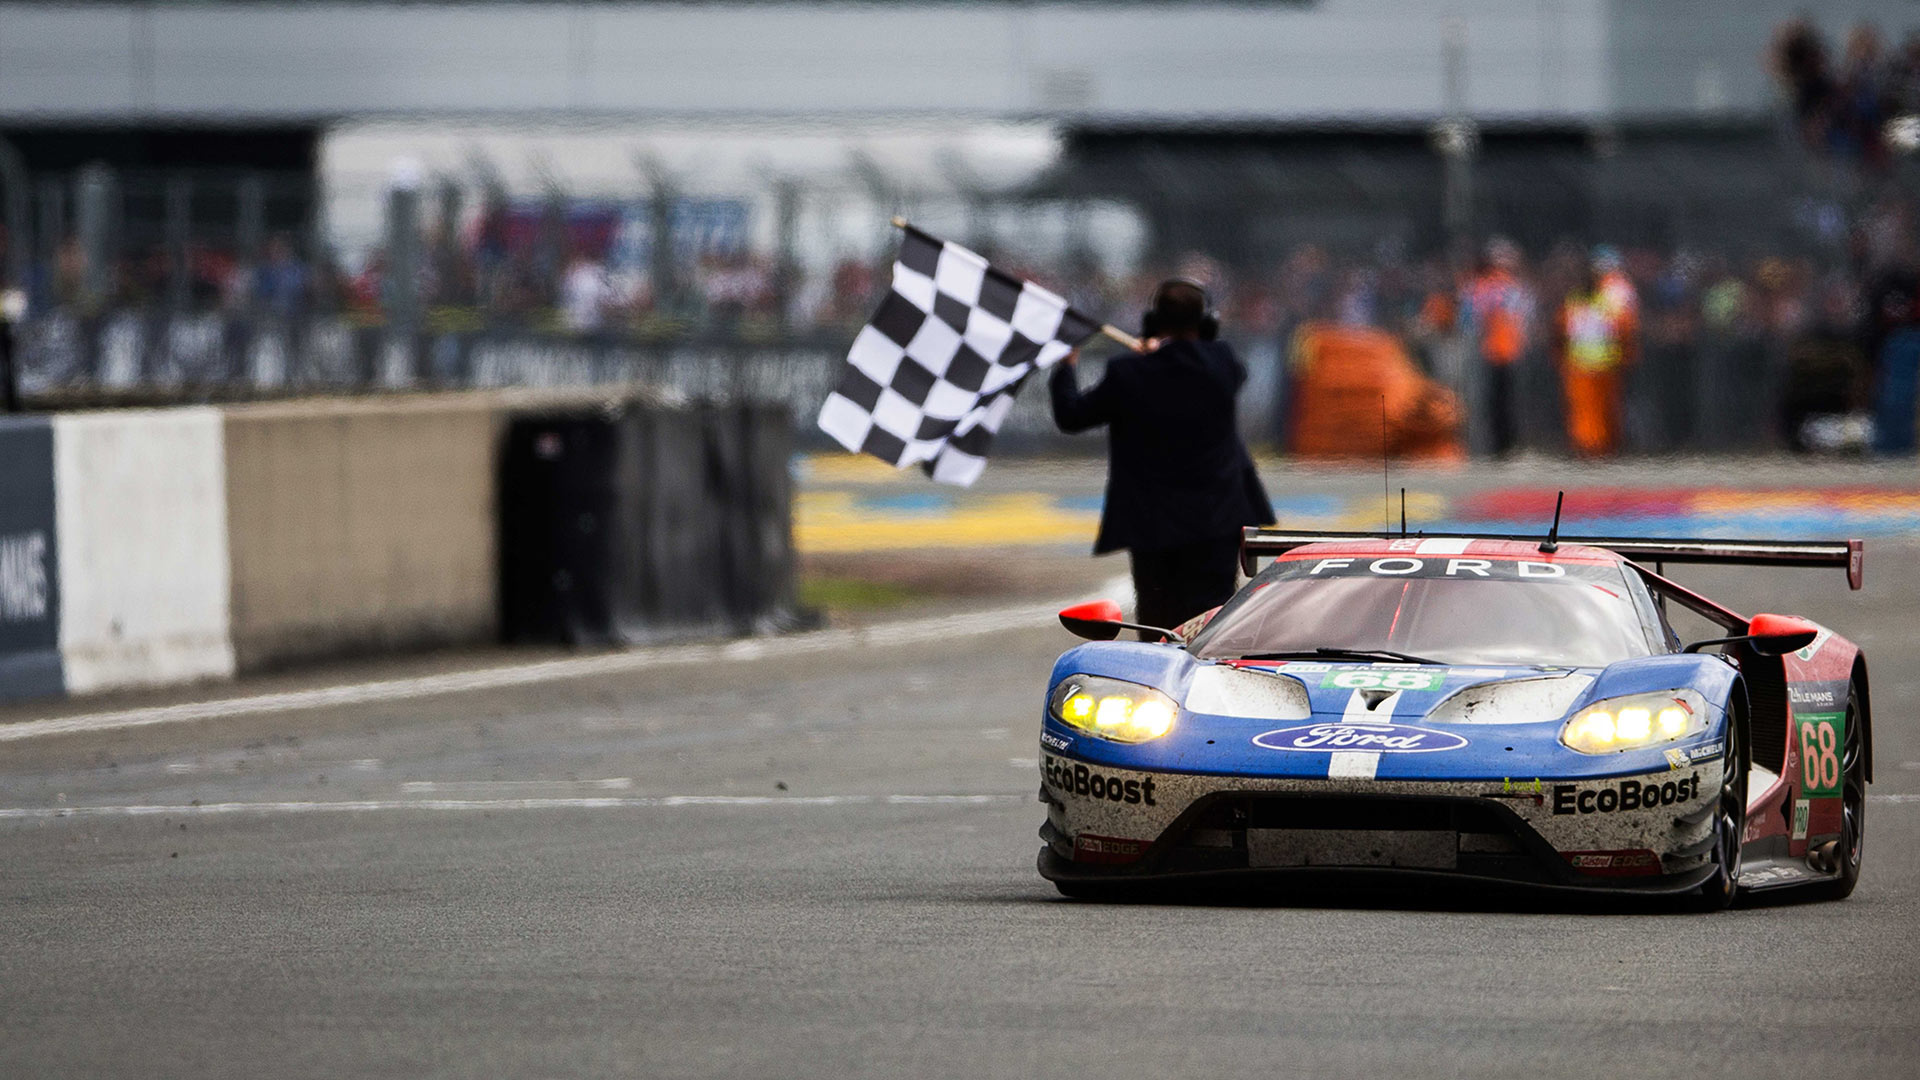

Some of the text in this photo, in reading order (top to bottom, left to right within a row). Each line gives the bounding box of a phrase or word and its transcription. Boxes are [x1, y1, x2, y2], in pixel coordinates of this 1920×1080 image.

[1310, 558, 1566, 578] FORD
[1333, 671, 1431, 689] 68
[1294, 726, 1422, 748] Ford
[1801, 721, 1839, 790] 68
[1046, 755, 1156, 806] EcoBoost
[1553, 771, 1700, 815] EcoBoost
[1103, 841, 1141, 855] EDGE
[1612, 855, 1653, 867] EDGE
